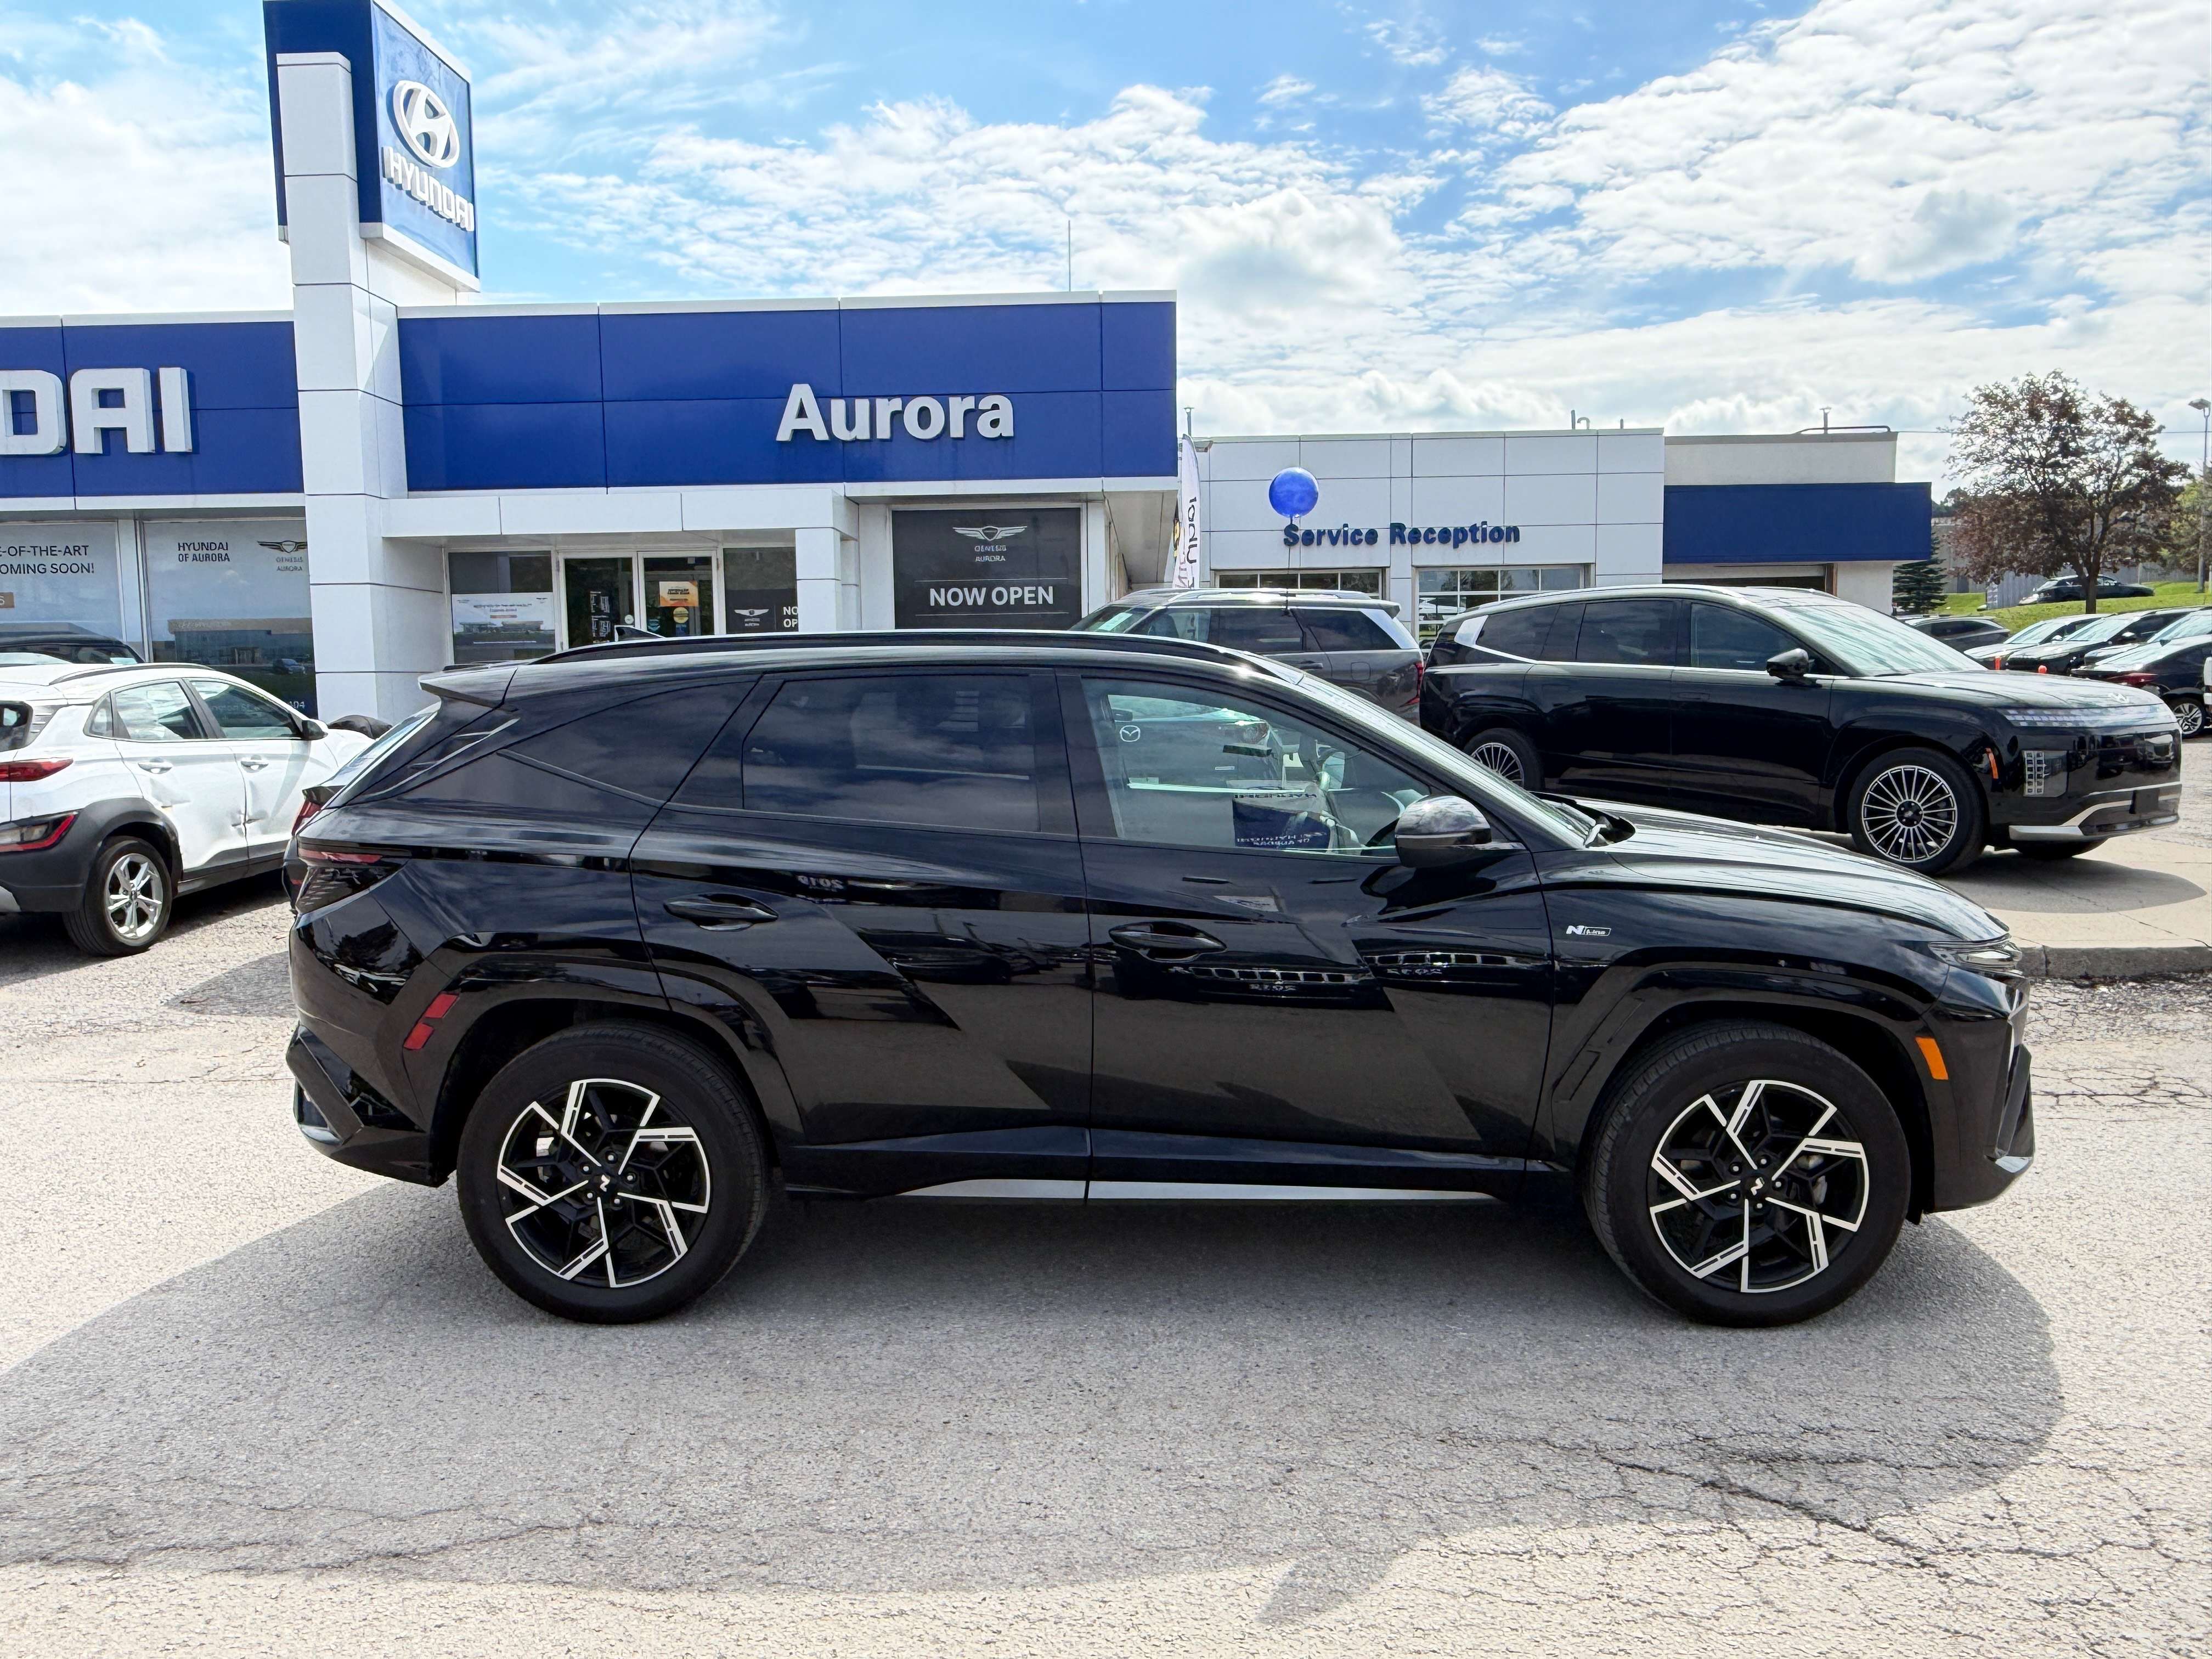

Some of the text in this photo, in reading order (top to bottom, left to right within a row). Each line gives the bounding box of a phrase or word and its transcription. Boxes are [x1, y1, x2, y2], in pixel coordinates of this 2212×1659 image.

[382, 146, 475, 232] HYUNDAI
[0, 367, 193, 455] DAI
[776, 383, 1014, 441] Aurora
[1283, 521, 1520, 549] Service Reception
[0, 545, 89, 557] -OF-THE-ART
[178, 541, 229, 551] HYUNDAI
[178, 552, 230, 562] OF AURORA
[50, 562, 94, 574] SOON!
[930, 586, 1054, 606] NOW OPEN
[1566, 925, 1585, 935] N
